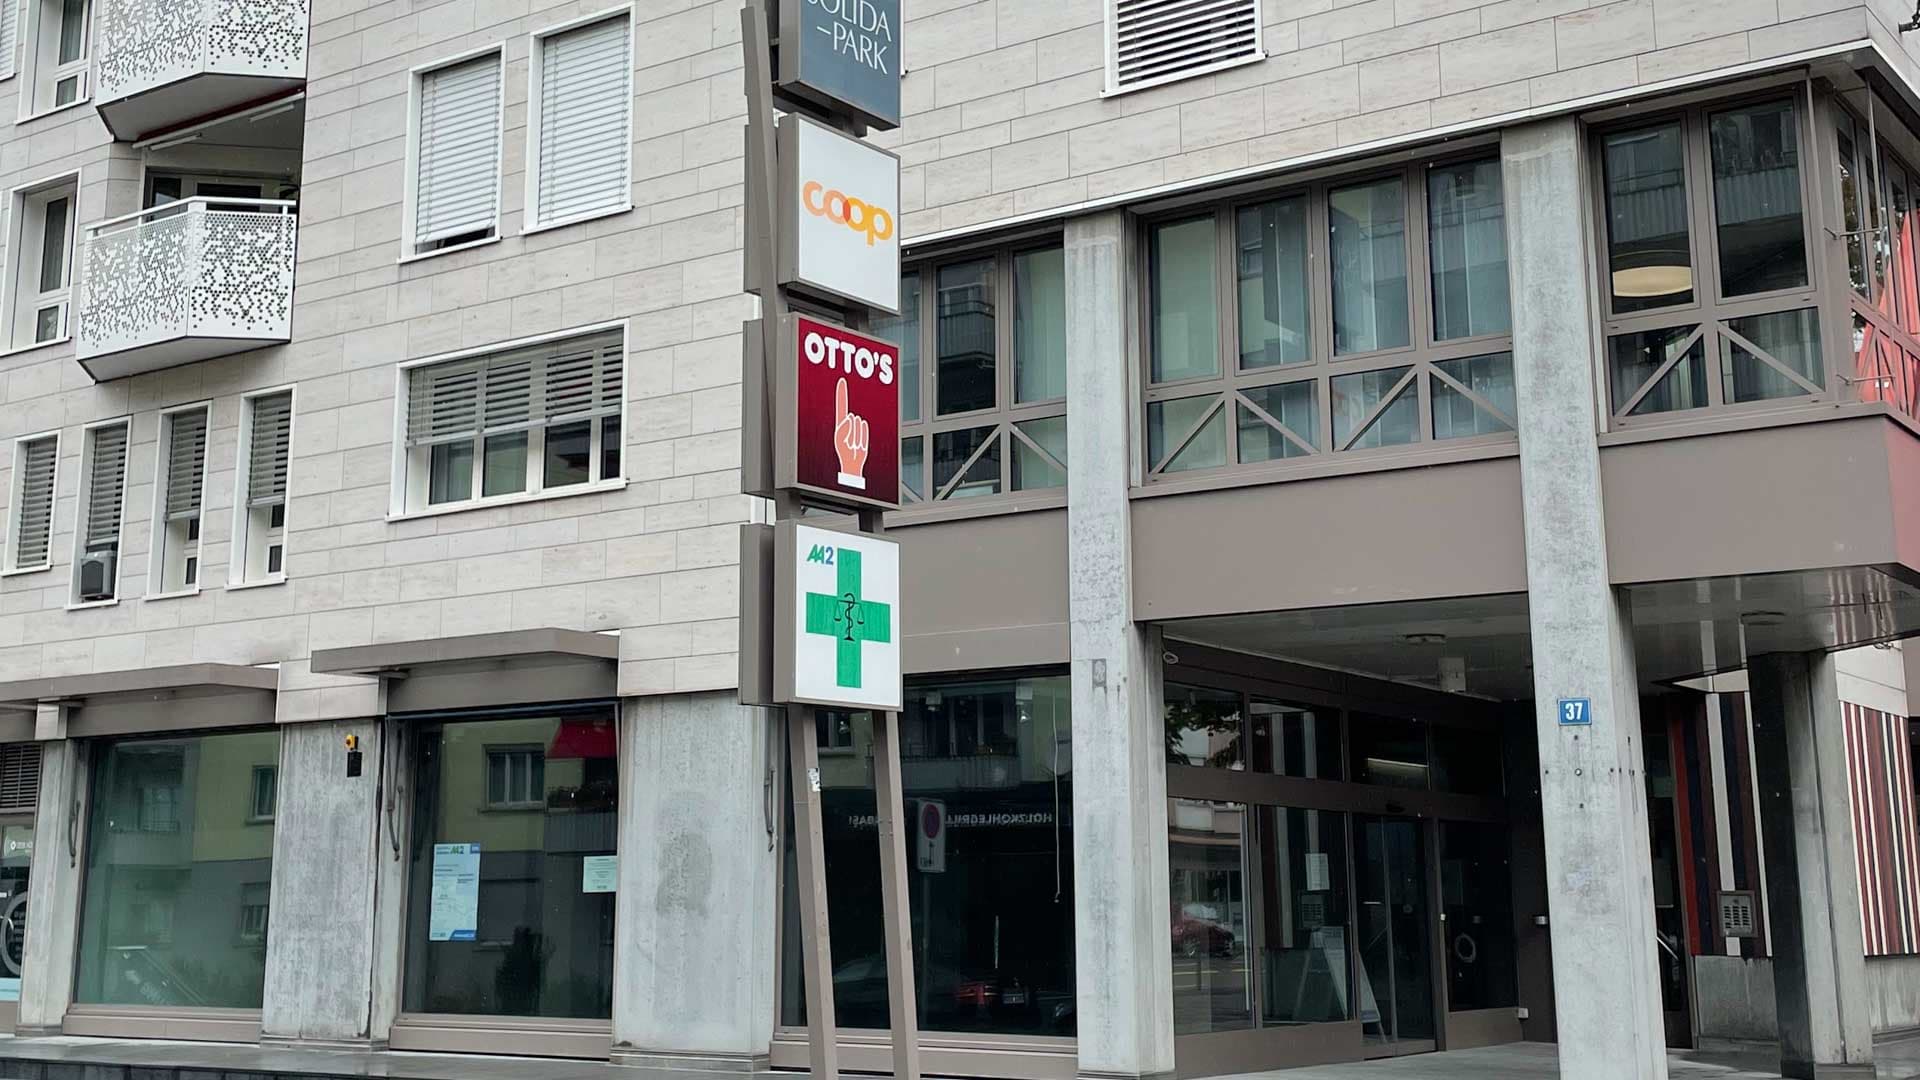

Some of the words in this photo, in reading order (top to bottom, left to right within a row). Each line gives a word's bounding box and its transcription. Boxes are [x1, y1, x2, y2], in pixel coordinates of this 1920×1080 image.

[808, 0, 892, 42] OLIDA
[803, 181, 893, 246] coop
[804, 332, 894, 385] OTTO'S
[1565, 702, 1583, 721] 37
